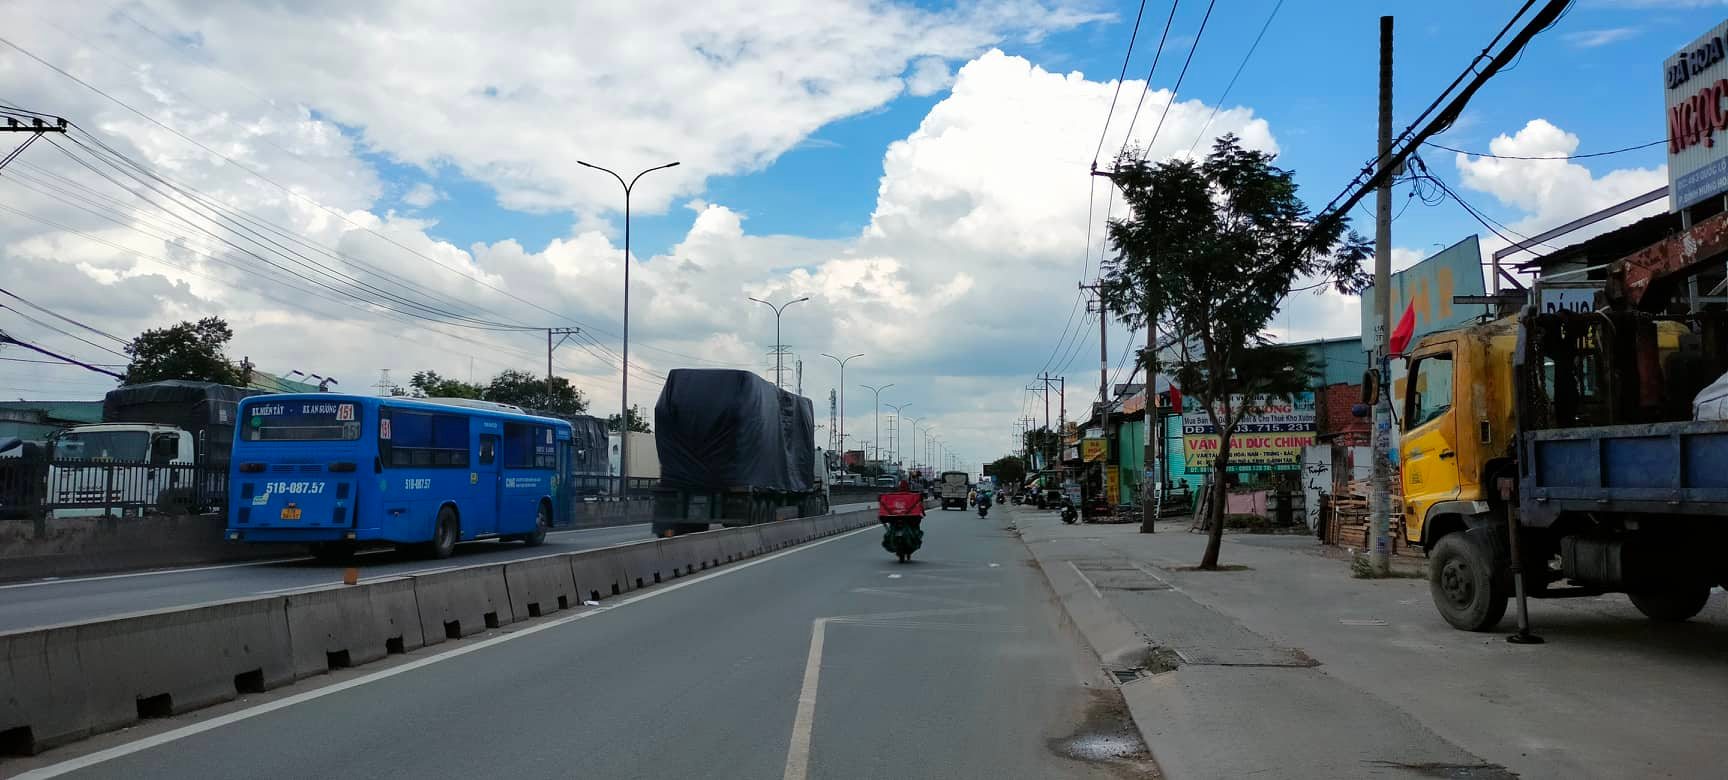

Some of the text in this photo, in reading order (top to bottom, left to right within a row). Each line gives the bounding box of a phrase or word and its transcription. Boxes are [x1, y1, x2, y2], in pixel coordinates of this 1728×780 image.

[1688, 37, 1725, 75] HOA
[1669, 79, 1728, 154] NGỌC
[338, 404, 353, 420] 151
[1288, 423, 1310, 431] 231
[1246, 437, 1271, 449] ĐỨC
[1274, 436, 1312, 448] CHÍNH
[266, 482, 325, 494] 51B-087.57
